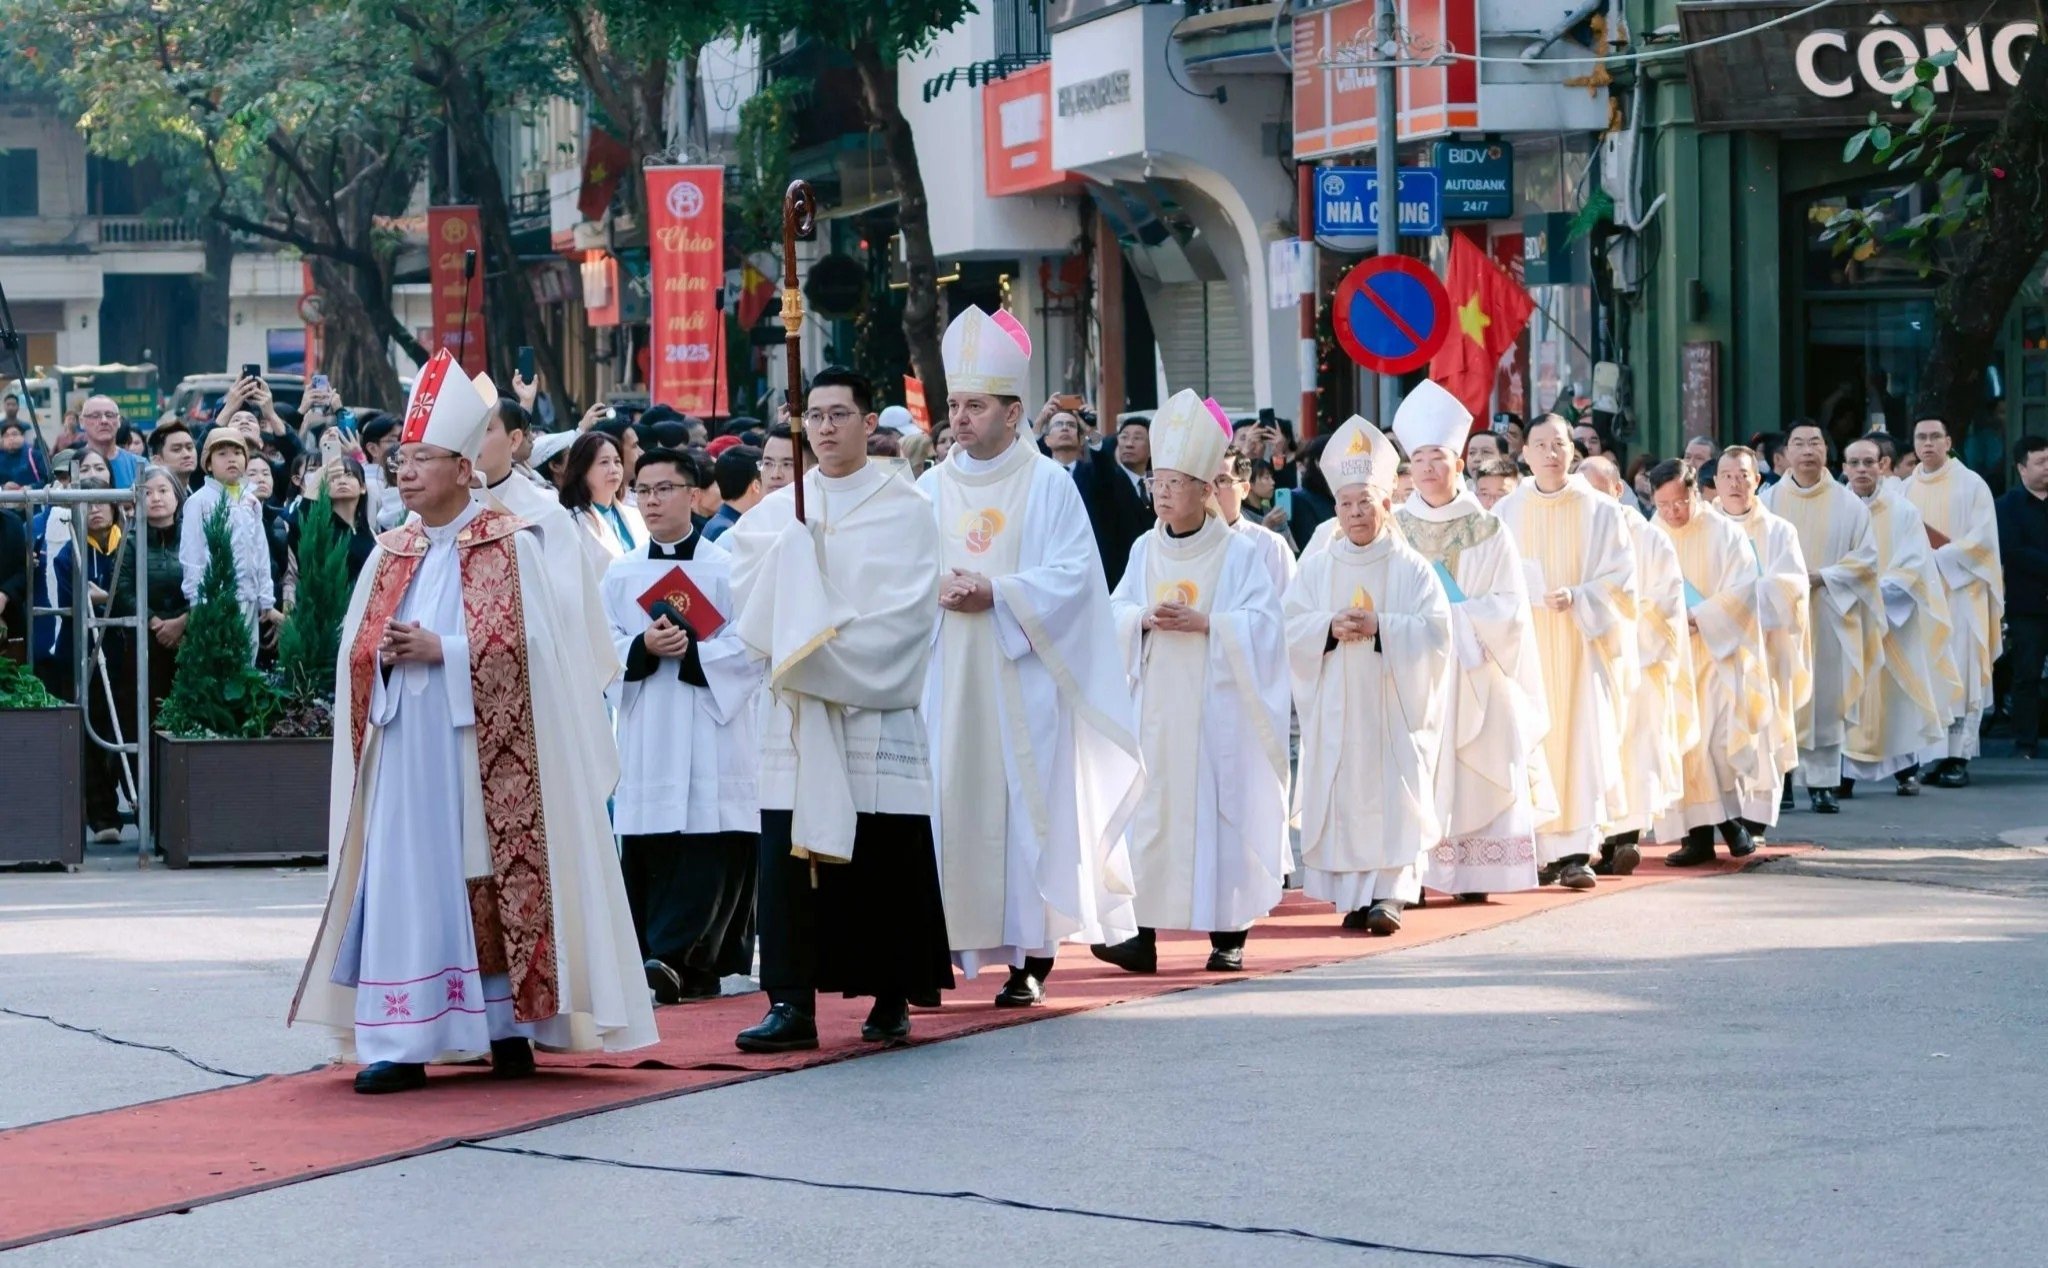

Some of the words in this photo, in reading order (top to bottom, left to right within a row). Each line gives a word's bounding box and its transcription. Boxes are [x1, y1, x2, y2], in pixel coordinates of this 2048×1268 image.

[1449, 148, 1488, 163] BIDV
[1445, 179, 1506, 191] AUTOBANK
[1326, 196, 1364, 223] NHÀ
[1463, 201, 1489, 212] 24/7
[656, 225, 714, 253] Chào
[664, 272, 709, 292] năm
[667, 309, 707, 332] mới
[665, 344, 711, 362] 2025
